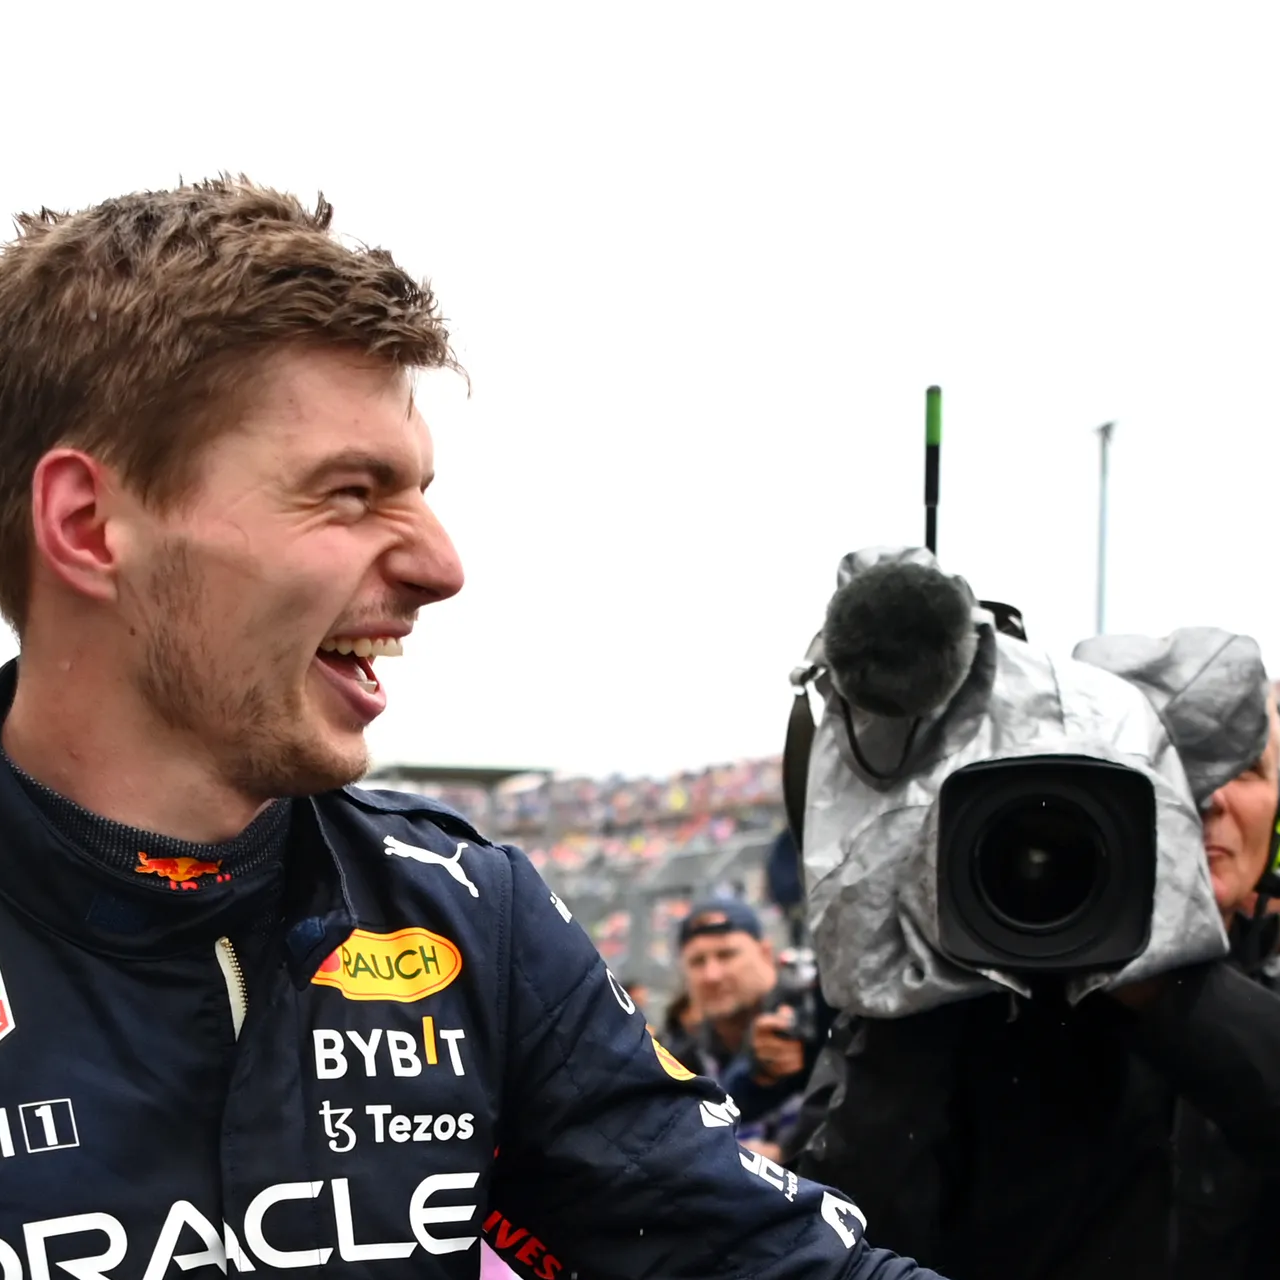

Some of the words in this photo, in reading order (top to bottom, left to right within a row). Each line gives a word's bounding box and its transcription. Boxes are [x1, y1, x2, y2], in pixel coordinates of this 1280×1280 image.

[341, 945, 441, 981] RAUCH
[312, 1016, 466, 1079] BYBIT
[365, 1105, 475, 1143] Tezos
